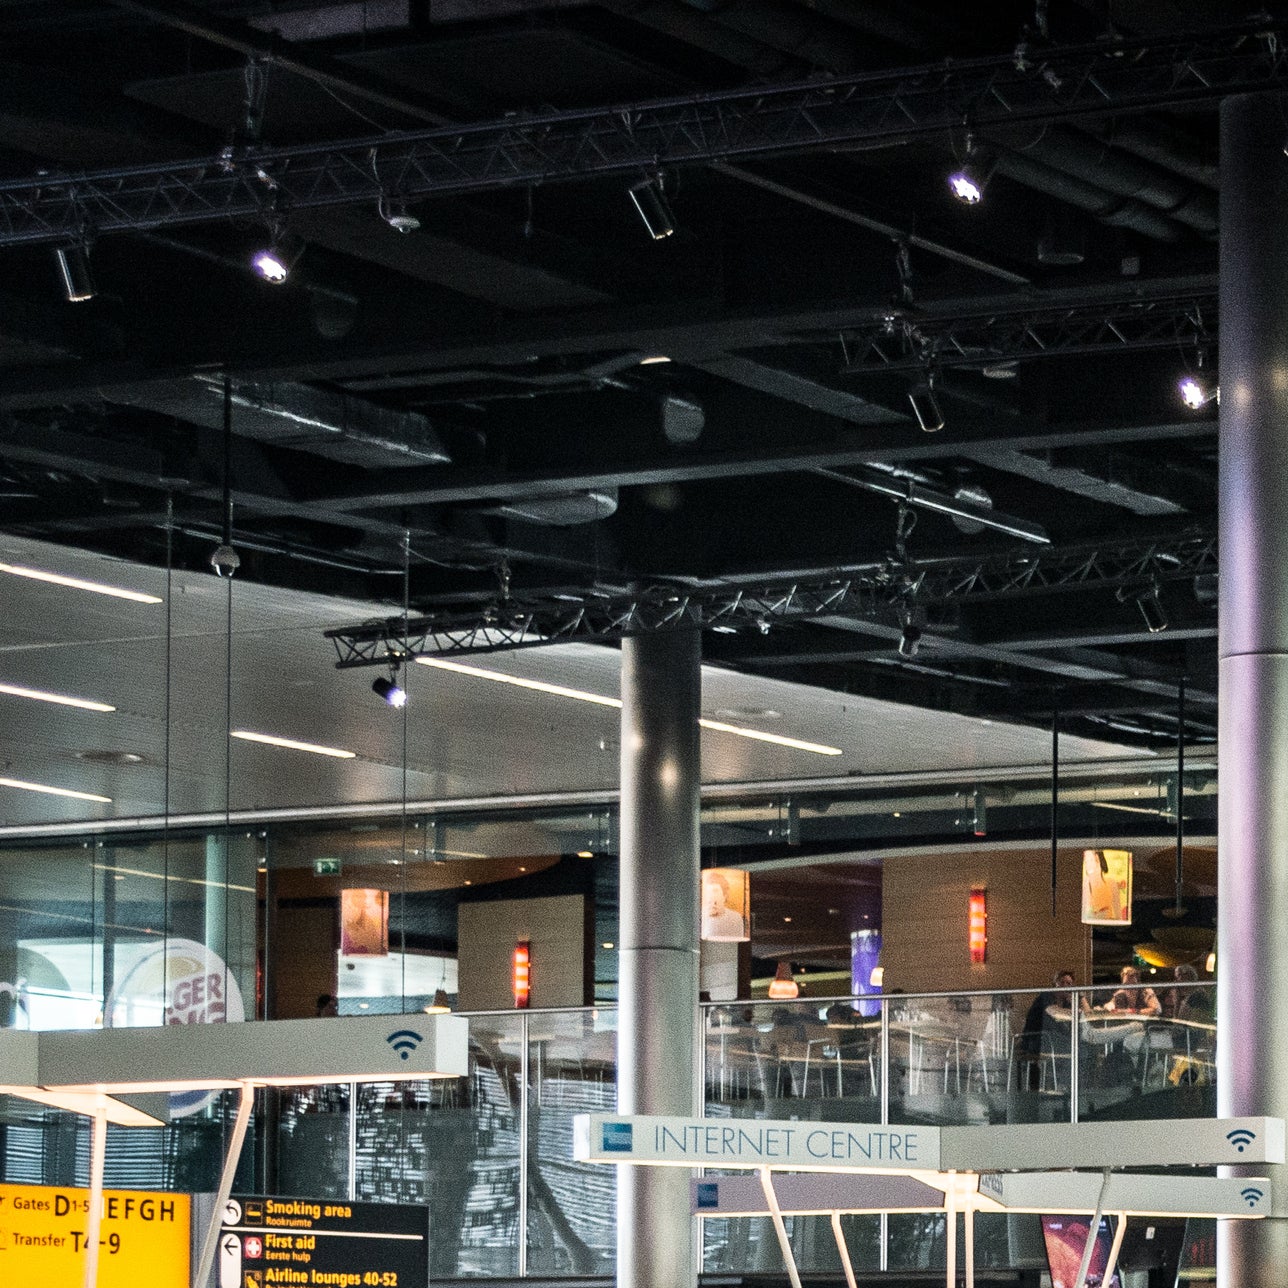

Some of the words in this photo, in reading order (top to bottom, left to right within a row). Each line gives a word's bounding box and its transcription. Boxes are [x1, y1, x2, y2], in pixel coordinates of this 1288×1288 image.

[655, 1125, 796, 1157] INTERNET
[806, 1130, 918, 1161] CENTRE
[13, 1197, 51, 1211] Gates
[265, 1200, 322, 1219] Smoking
[324, 1203, 353, 1218] area
[13, 1232, 66, 1247] Transfer
[265, 1235, 293, 1249] First
[295, 1236, 315, 1250] aid
[265, 1269, 308, 1284] Airline
[311, 1270, 361, 1287] lounges
[363, 1272, 398, 1288] 40-52
